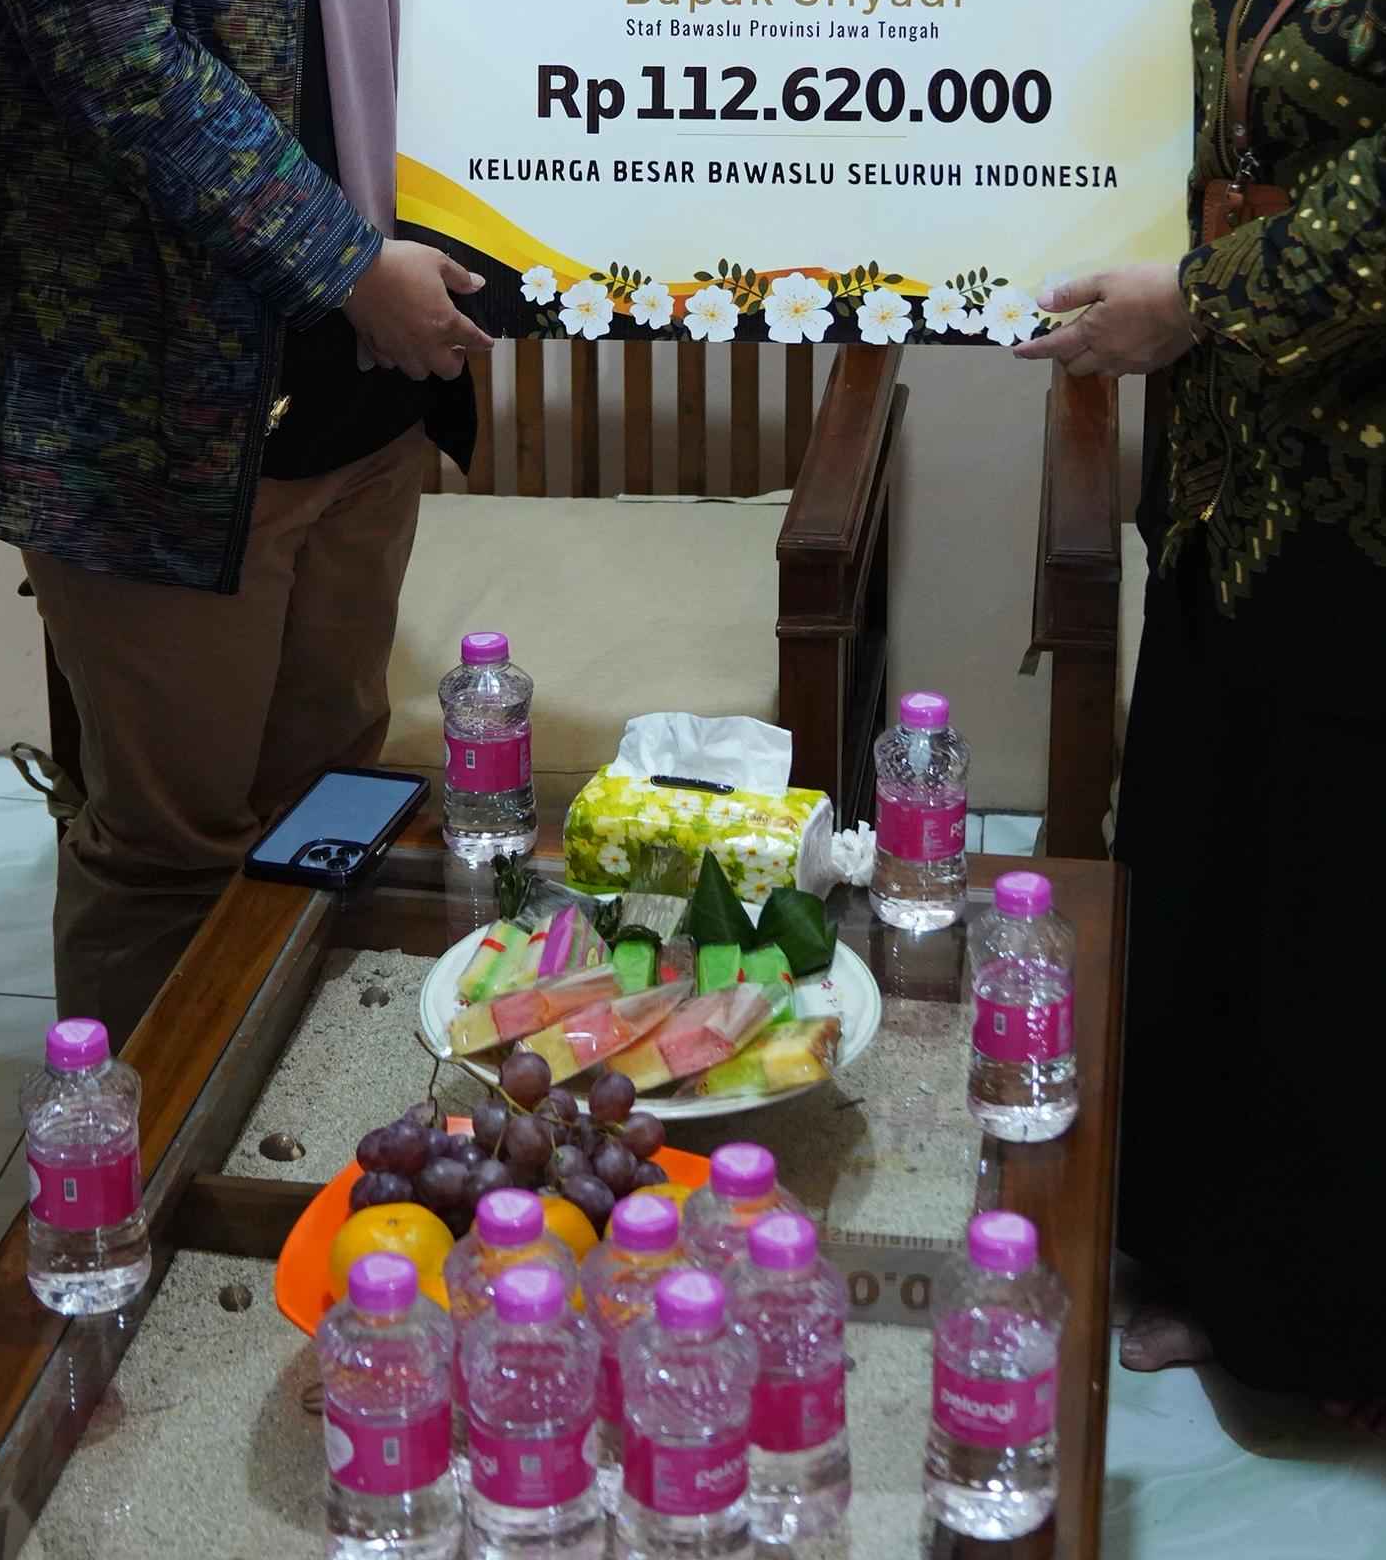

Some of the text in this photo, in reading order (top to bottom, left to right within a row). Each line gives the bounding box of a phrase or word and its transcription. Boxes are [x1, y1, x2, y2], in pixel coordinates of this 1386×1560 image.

[626, 18, 939, 43] Staf Bawaslu Provinsi Jawa Tengah
[469, 158, 1118, 188] KELUARGA BESAR BAWASLU SELURUH INDONESIA
